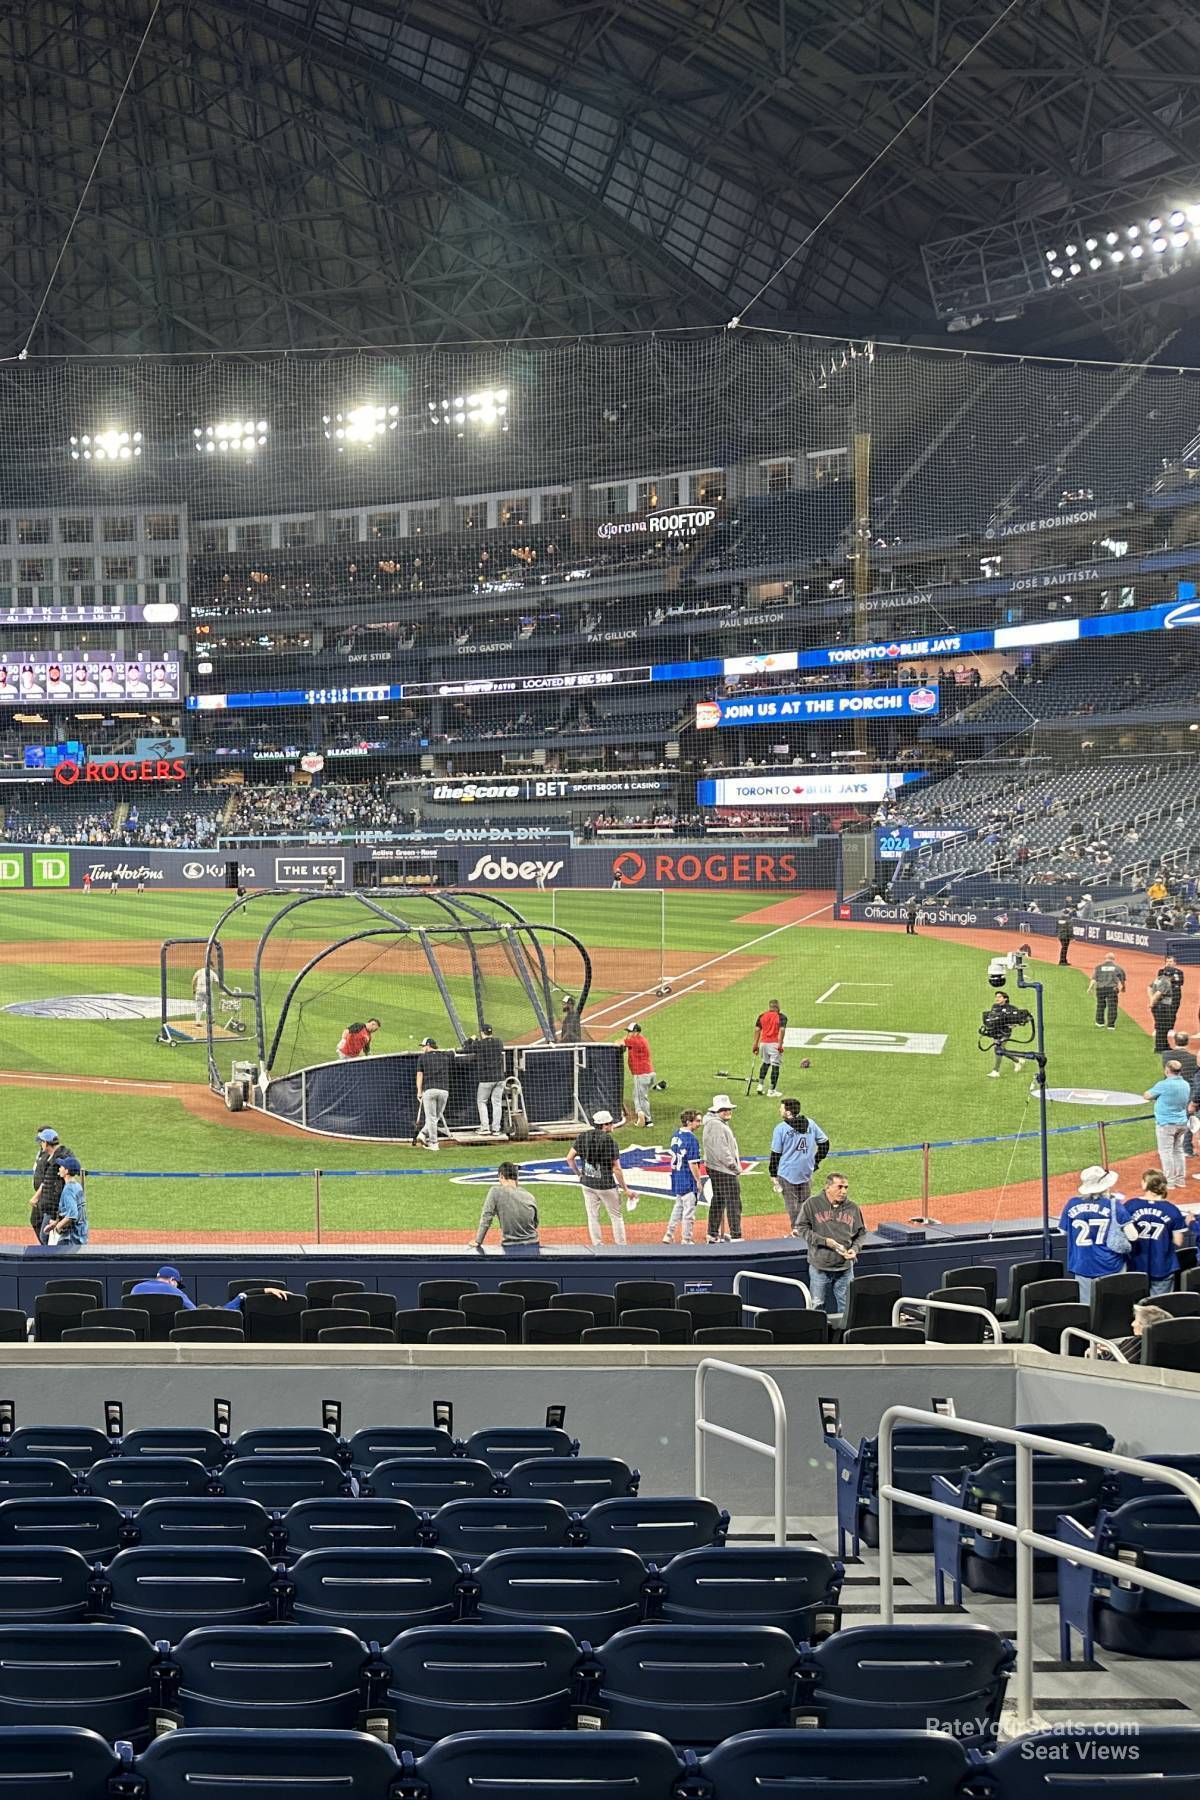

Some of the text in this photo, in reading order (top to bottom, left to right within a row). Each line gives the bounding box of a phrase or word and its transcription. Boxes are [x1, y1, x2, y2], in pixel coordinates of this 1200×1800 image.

[598, 511, 715, 539] Corona ROOFTOP
[1000, 510, 1097, 536] JACKIE ROBINSON
[668, 528, 697, 538] PATIO
[1009, 569, 1099, 591] JOSÉ BAUTISTA
[859, 601, 879, 612] ROY
[881, 594, 932, 609] HALLADAY
[719, 613, 784, 628] PAUL BEESTON
[588, 630, 638, 642] PAT GILLICK
[458, 642, 513, 654] CITO GASTON
[828, 638, 961, 662] TORONTO BLUE JAYS
[2, 654, 7, 663] 3
[111, 653, 116, 661] 7
[370, 653, 391, 661] STIEB
[35, 665, 46, 674] 64
[63, 665, 72, 673] 13
[116, 664, 124, 673] 12
[523, 677, 563, 688] LOCATED
[564, 676, 577, 686] RF
[578, 675, 595, 685] SEC
[725, 706, 753, 719] JOIN
[758, 703, 776, 715] US
[781, 701, 801, 714] AT
[805, 699, 834, 713] THE
[839, 695, 902, 711] PORCH!
[253, 751, 285, 759] CANADA
[327, 748, 368, 757] BLEACHERS
[86, 760, 186, 782] ROGERS
[433, 784, 519, 799] theScore
[535, 781, 568, 797] BET
[573, 784, 622, 792] SPORTSBOOK
[631, 782, 660, 790] CASINO
[736, 783, 868, 796] TORONTO JAYS
[444, 828, 513, 840] CANADA
[880, 837, 910, 851] 2024
[36, 858, 65, 880] TD
[89, 863, 164, 881] Tim Hortons
[283, 866, 337, 875] THE KEG
[468, 855, 564, 881] Sobeys
[656, 855, 797, 882] ROGERS
[864, 907, 976, 925] Official Shingle
[1088, 927, 1100, 939] BET
[1105, 930, 1149, 947] BASELINE BOX
[795, 1137, 808, 1154] 4
[1072, 1219, 1110, 1246] 27
[1137, 1221, 1165, 1240] 27
